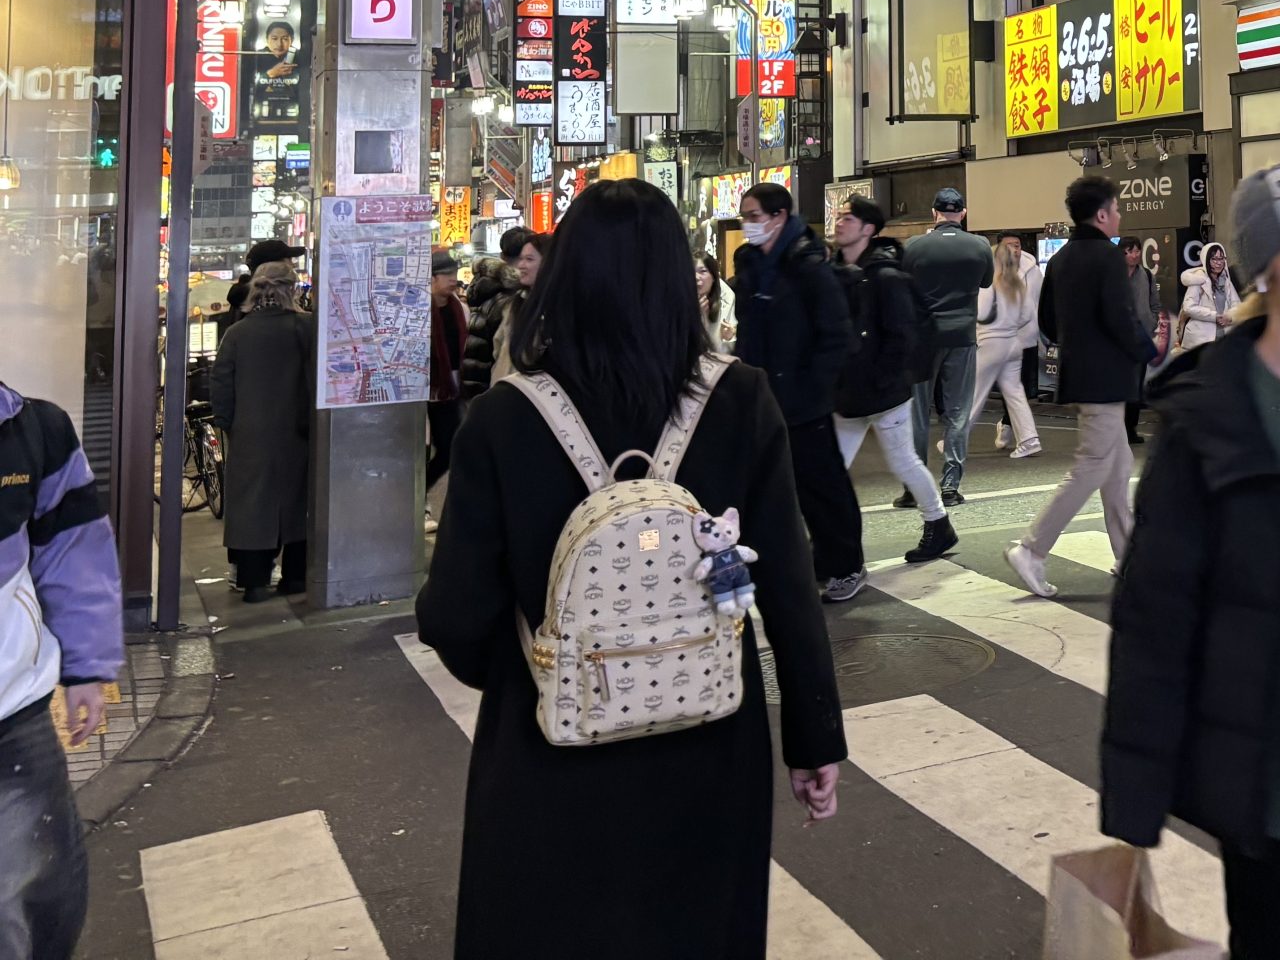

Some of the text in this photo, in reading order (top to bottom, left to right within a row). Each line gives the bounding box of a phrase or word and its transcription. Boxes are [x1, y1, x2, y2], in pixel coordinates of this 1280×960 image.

[760, 20, 785, 36] 50
[765, 37, 781, 53] 円
[1119, 15, 1132, 90] 格安
[1070, 63, 1101, 107] 酒場
[1135, 55, 1181, 113] サワー
[1126, 199, 1166, 212] ENERGY
